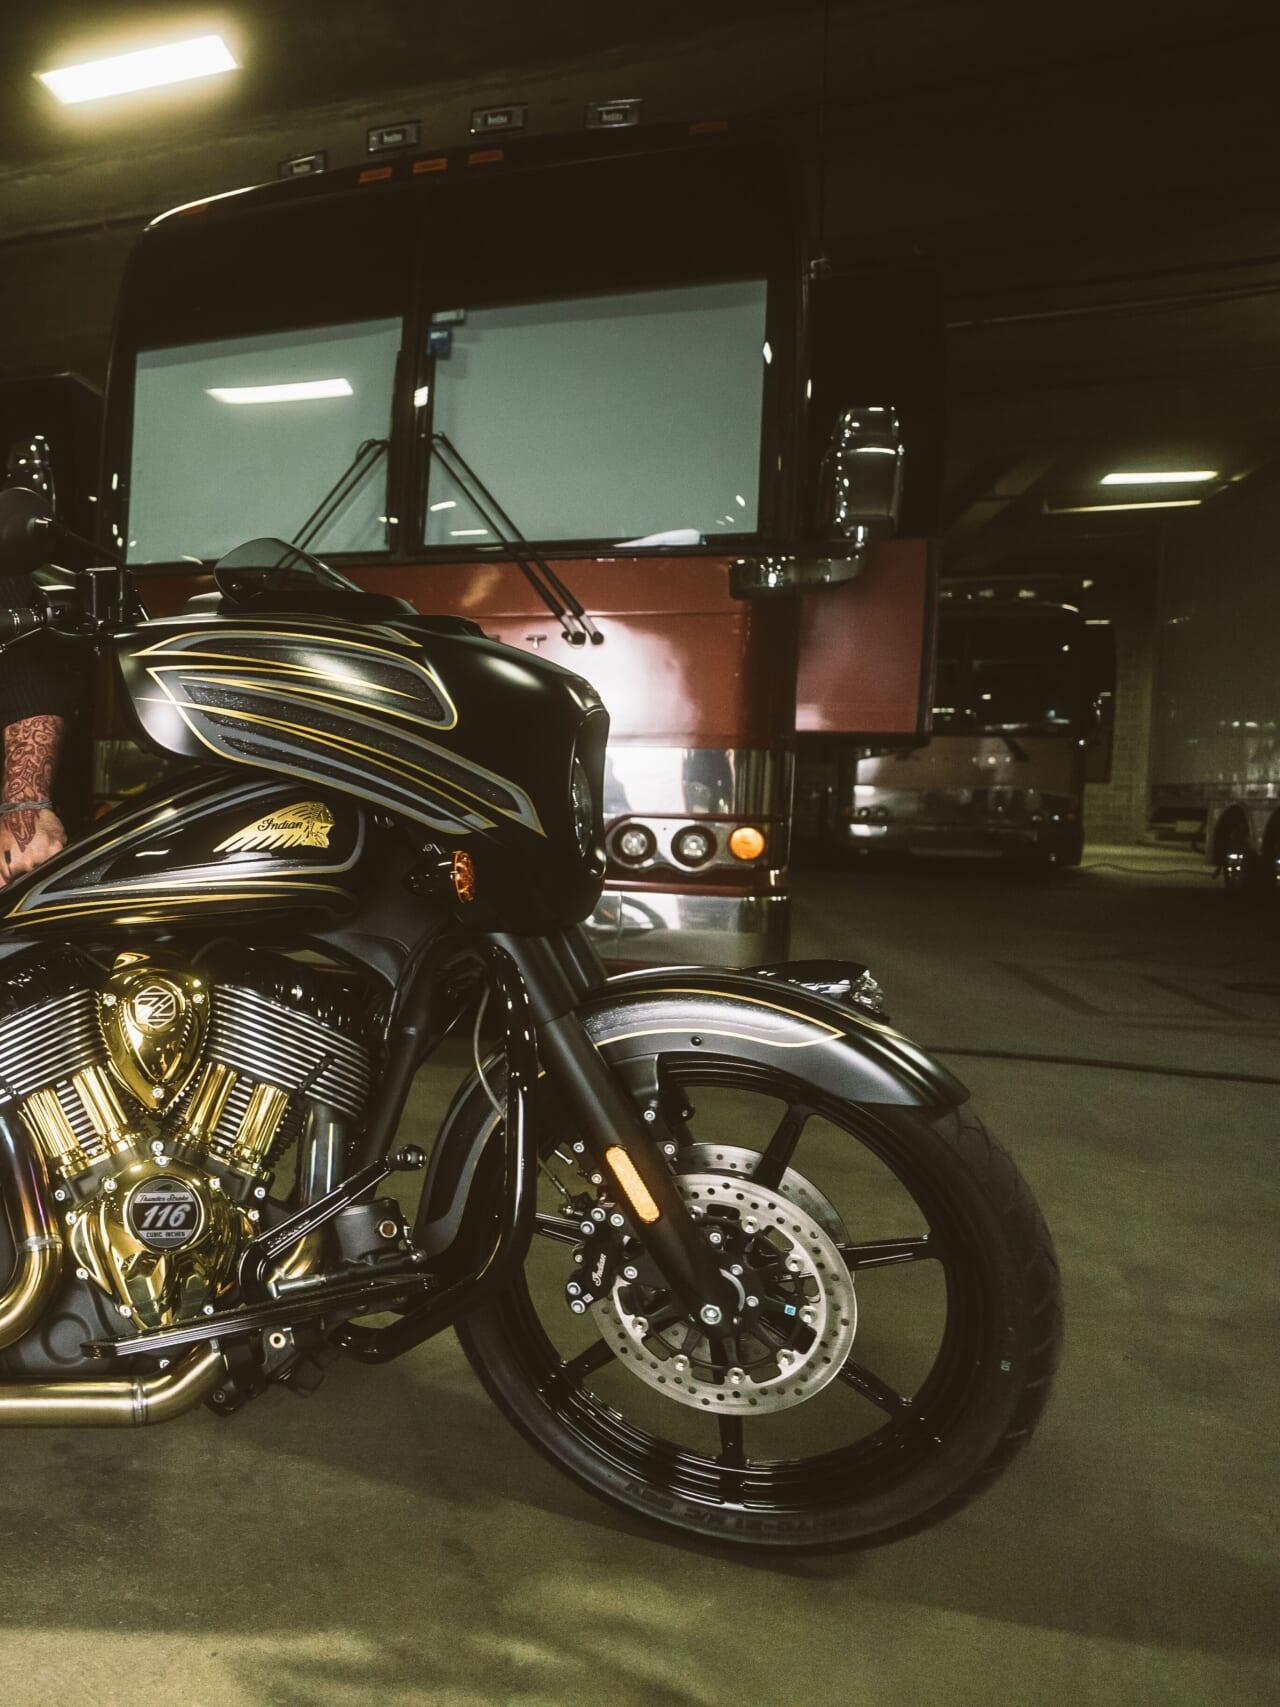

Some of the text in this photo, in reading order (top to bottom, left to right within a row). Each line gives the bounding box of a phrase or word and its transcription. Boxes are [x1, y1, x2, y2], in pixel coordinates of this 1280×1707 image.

[257, 817, 304, 832] Indian
[141, 1203, 191, 1228] 116
[591, 1252, 607, 1287] Indian
